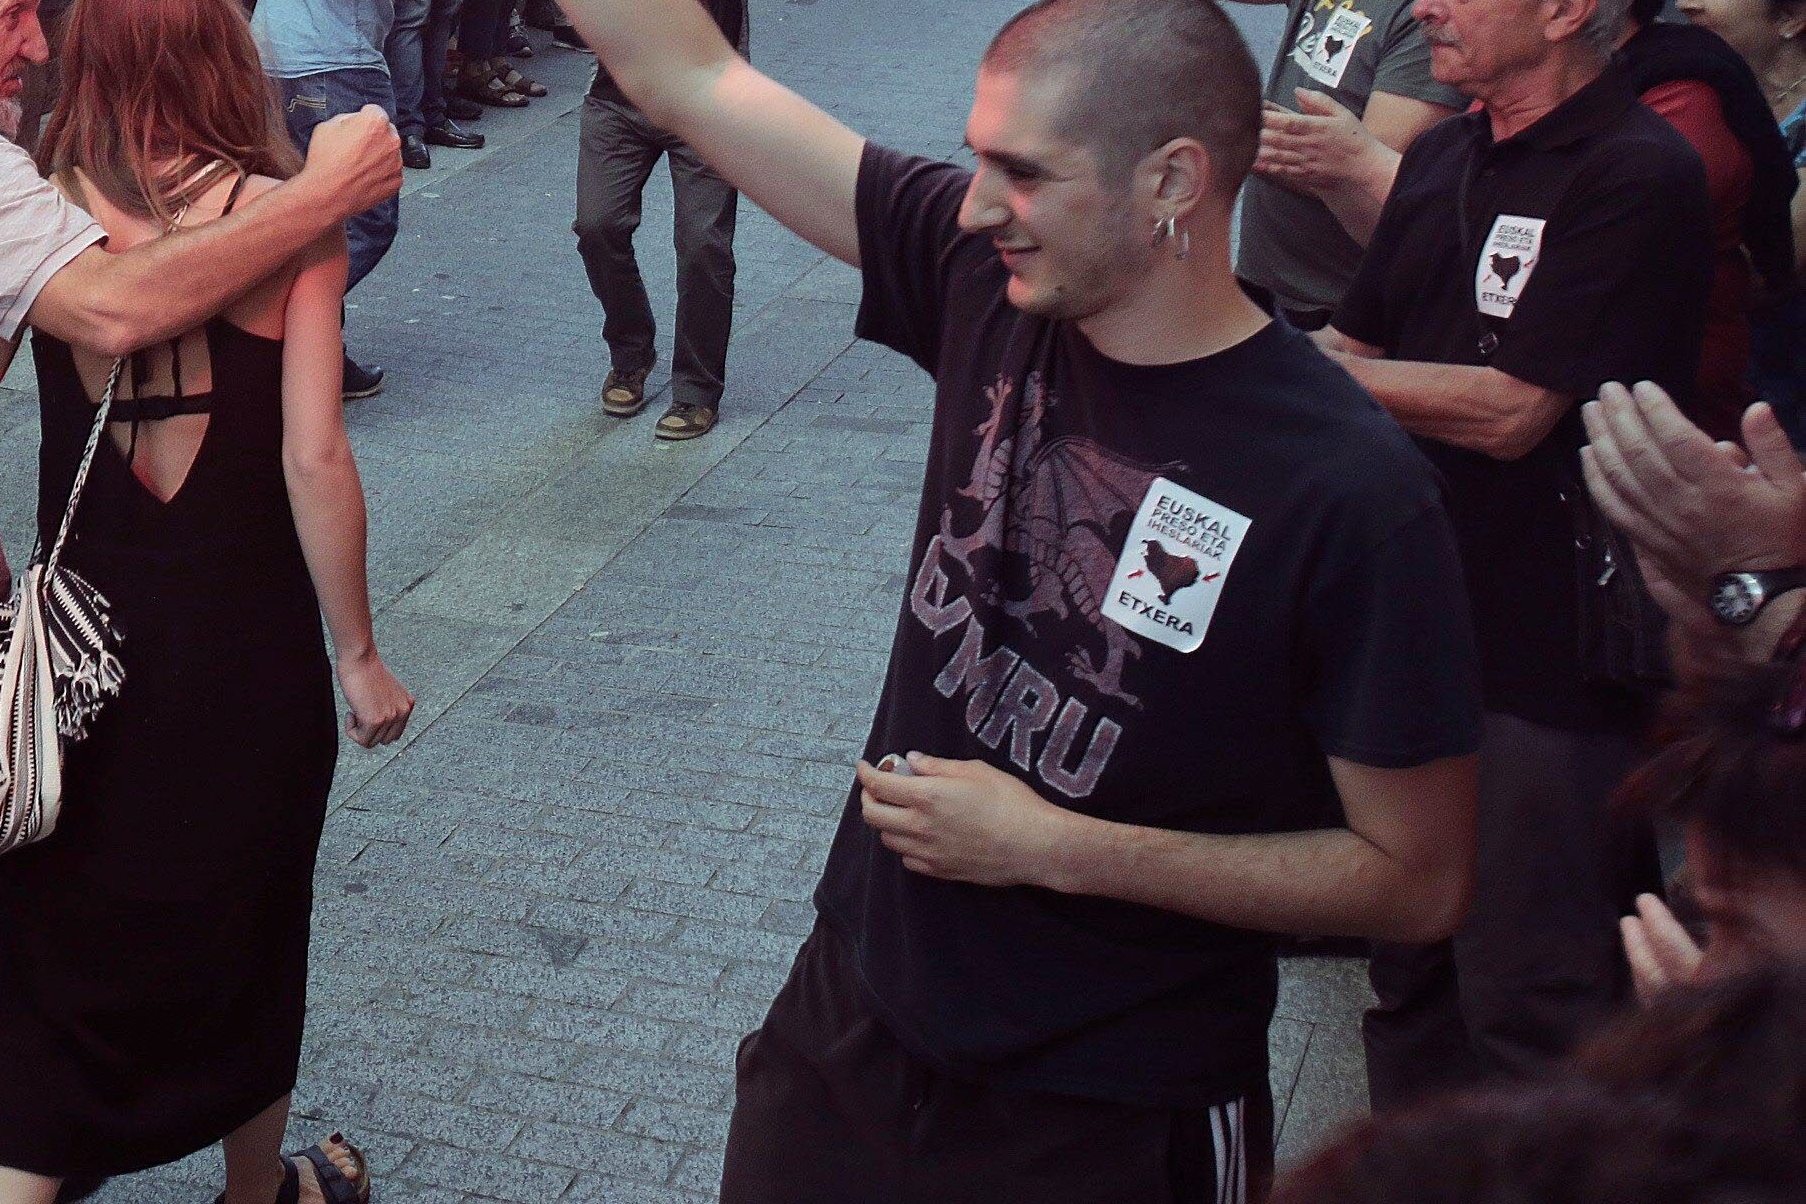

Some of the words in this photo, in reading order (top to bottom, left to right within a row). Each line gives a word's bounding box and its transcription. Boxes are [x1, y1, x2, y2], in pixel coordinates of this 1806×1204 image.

[1498, 224, 1535, 237] EUSKAL
[1151, 509, 1197, 536] PRESO
[1200, 531, 1227, 551] ETA
[1156, 495, 1232, 542] EUSKAL
[1147, 519, 1223, 562] IHESLARIAK
[1118, 590, 1194, 636] ETXERA
